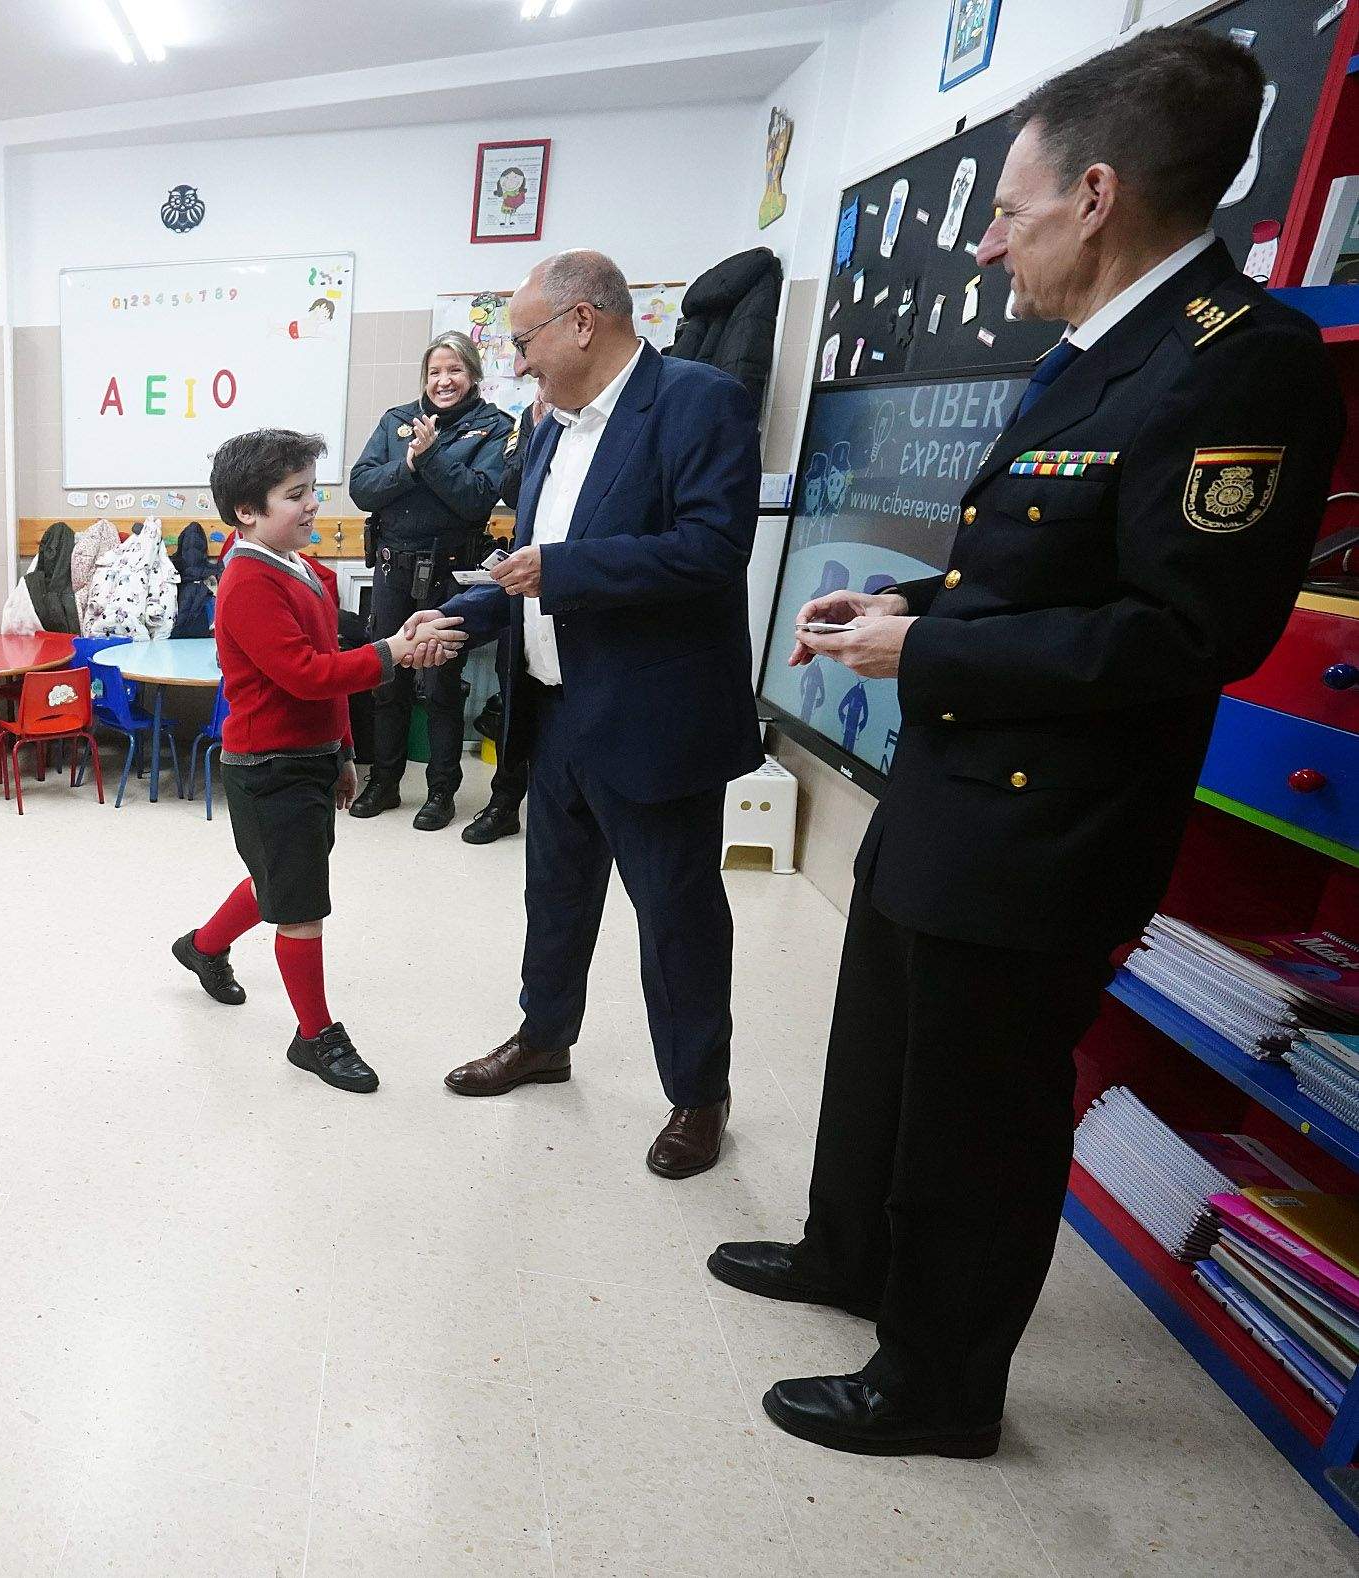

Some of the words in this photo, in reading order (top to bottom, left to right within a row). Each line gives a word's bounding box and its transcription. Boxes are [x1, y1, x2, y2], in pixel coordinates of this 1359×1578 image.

[229, 288, 238, 300] 9
[100, 376, 124, 416] A
[146, 374, 167, 416] E
[184, 377, 197, 418] I
[212, 368, 238, 409] O
[909, 379, 1010, 429] CIBER
